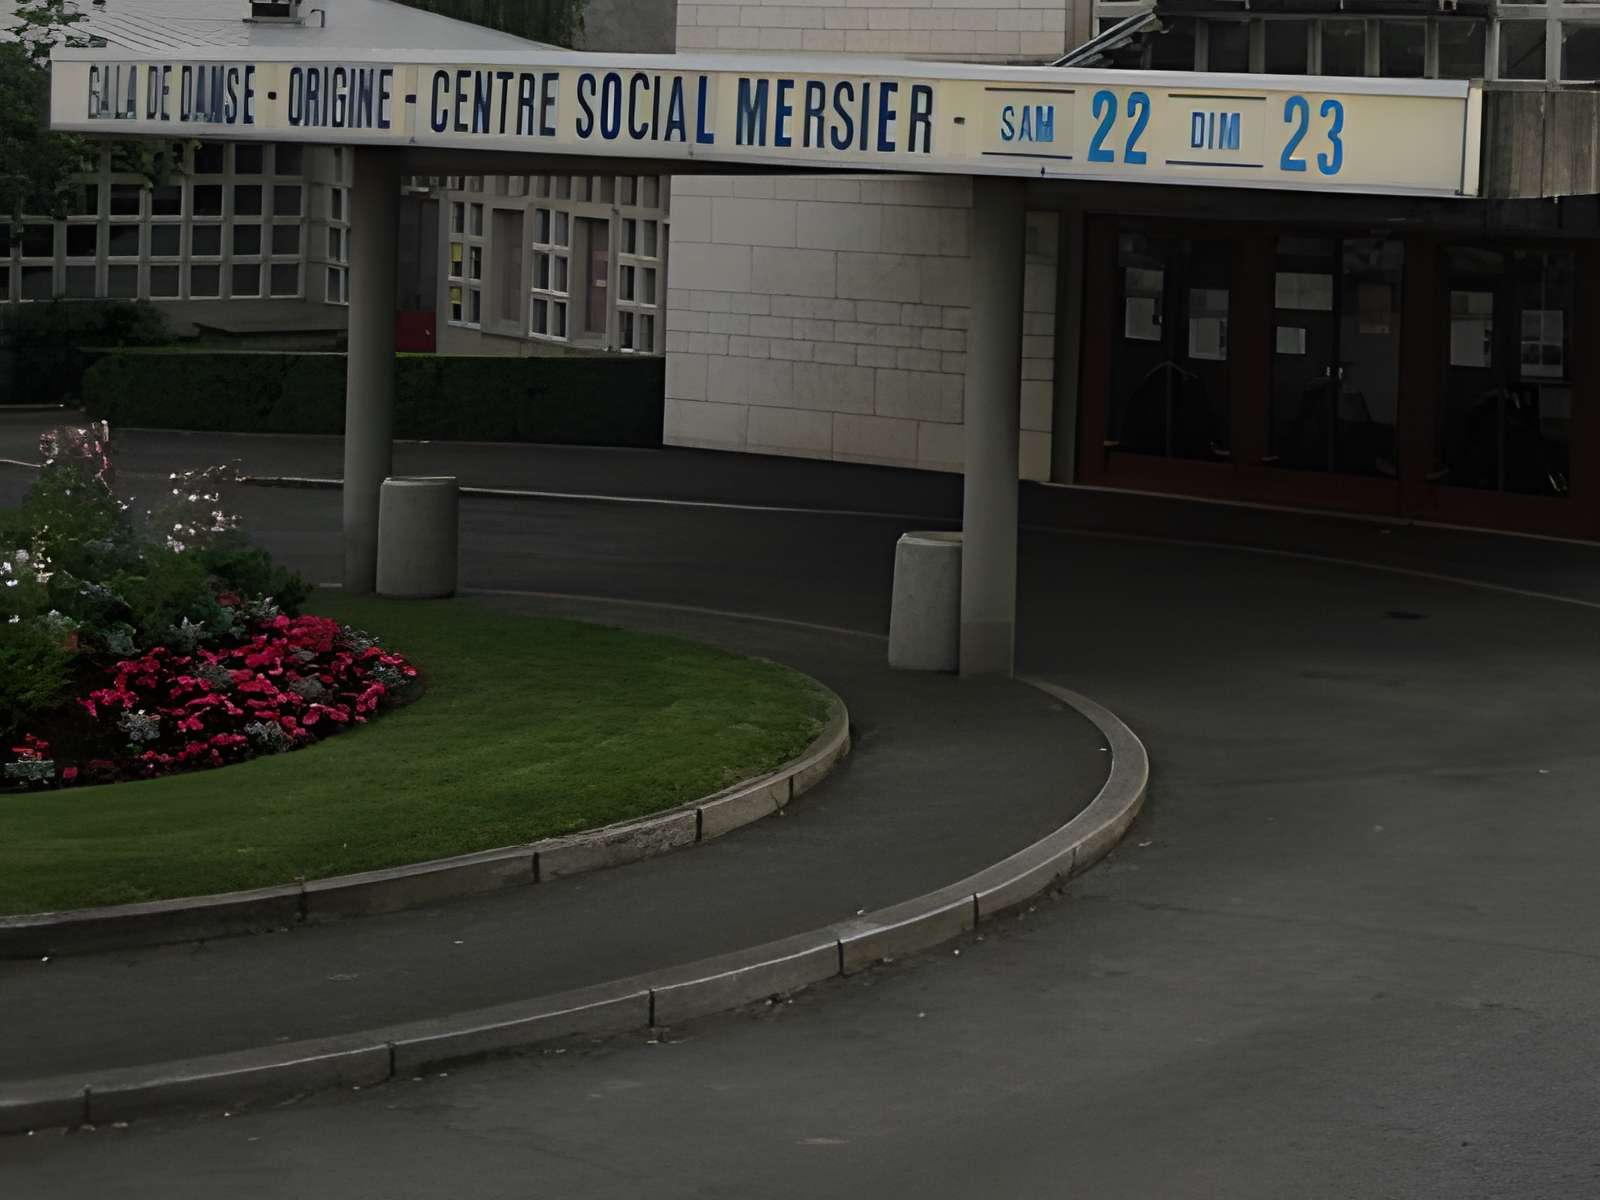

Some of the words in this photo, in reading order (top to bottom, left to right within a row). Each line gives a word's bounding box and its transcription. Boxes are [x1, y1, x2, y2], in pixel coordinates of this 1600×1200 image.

[88, 64, 137, 119] GALA
[147, 65, 172, 121] DE
[288, 66, 394, 129] ORIGINE
[431, 69, 560, 136] CENTRE
[576, 72, 715, 144] SOCIAL
[735, 77, 934, 154] MERSIER
[1000, 105, 1054, 142] SAM
[1088, 90, 1151, 165] 22
[1191, 112, 1241, 150] DIM
[1280, 95, 1345, 176] 23
